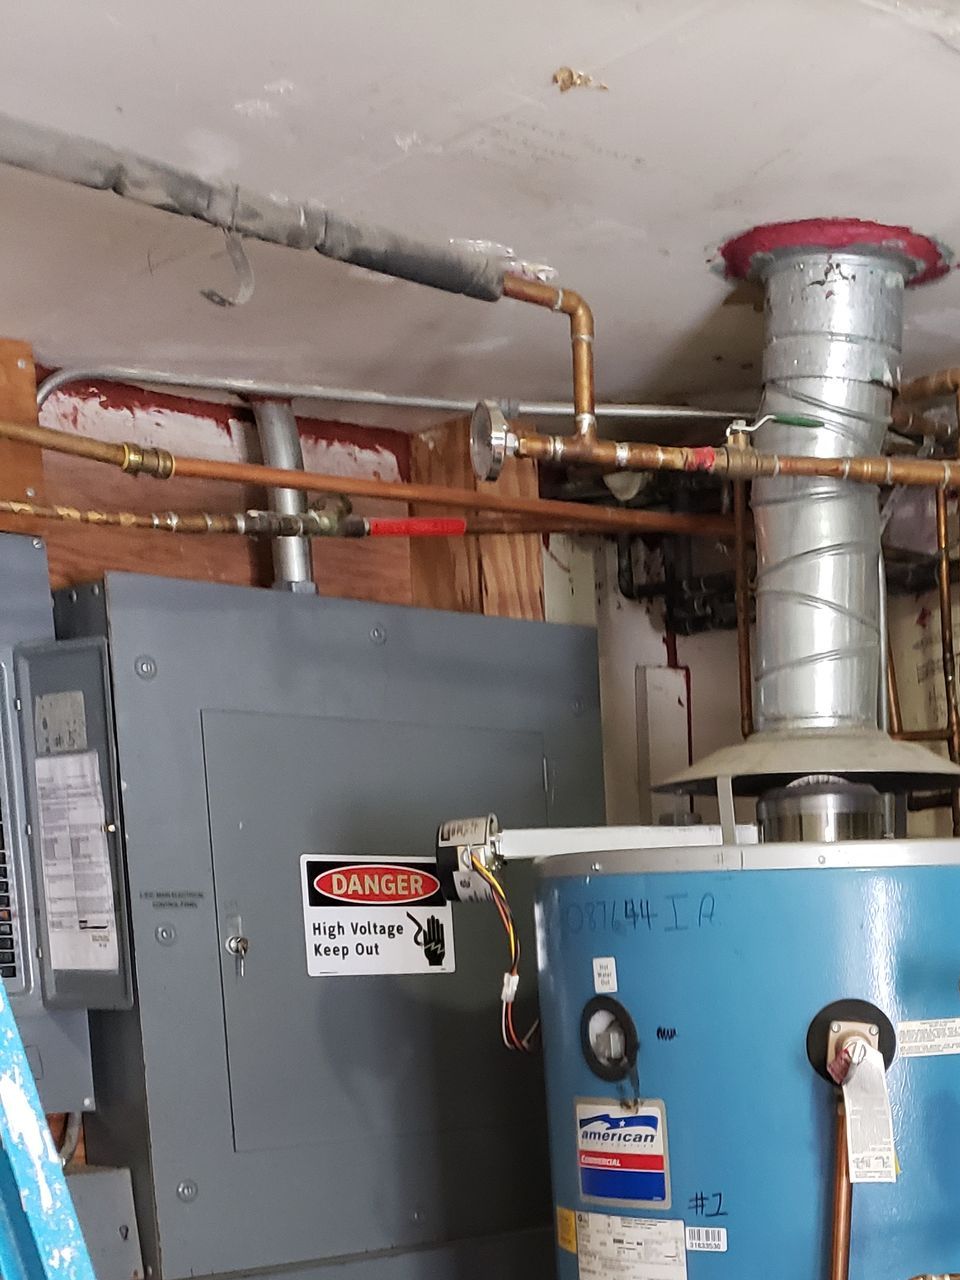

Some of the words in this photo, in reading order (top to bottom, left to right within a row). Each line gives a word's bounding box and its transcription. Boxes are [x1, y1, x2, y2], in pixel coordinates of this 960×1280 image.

[332, 873, 424, 896] DANGER
[312, 921, 345, 940] High
[350, 921, 404, 939] Voltage
[313, 943, 349, 960] Keep
[355, 943, 380, 956] Out
[581, 1130, 655, 1144] american
